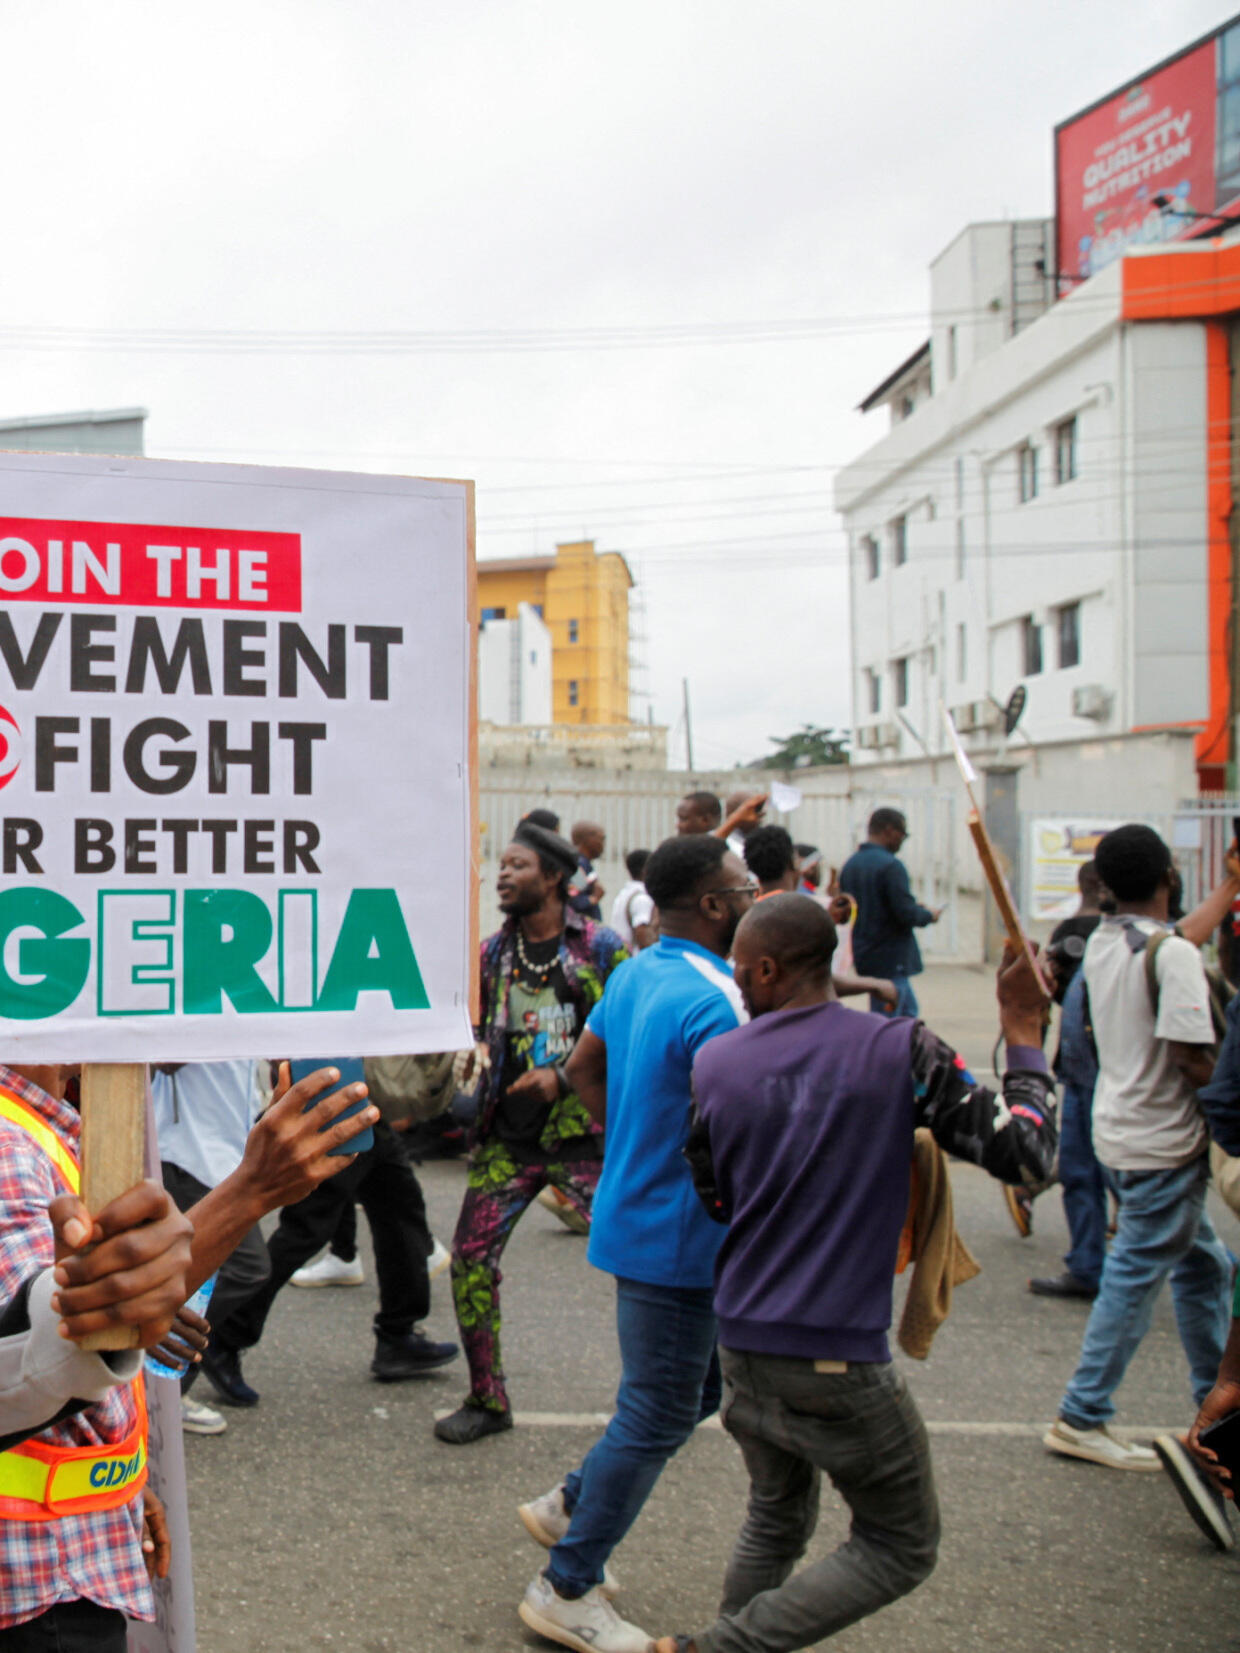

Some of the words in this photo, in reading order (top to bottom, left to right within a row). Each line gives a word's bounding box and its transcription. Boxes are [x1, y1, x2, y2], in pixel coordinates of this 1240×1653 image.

[1082, 137, 1192, 211] NUTRITION
[1083, 110, 1191, 189] QUALITY
[146, 545, 268, 602] THE
[35, 716, 327, 795] FIGHT
[74, 818, 322, 874] BETTER
